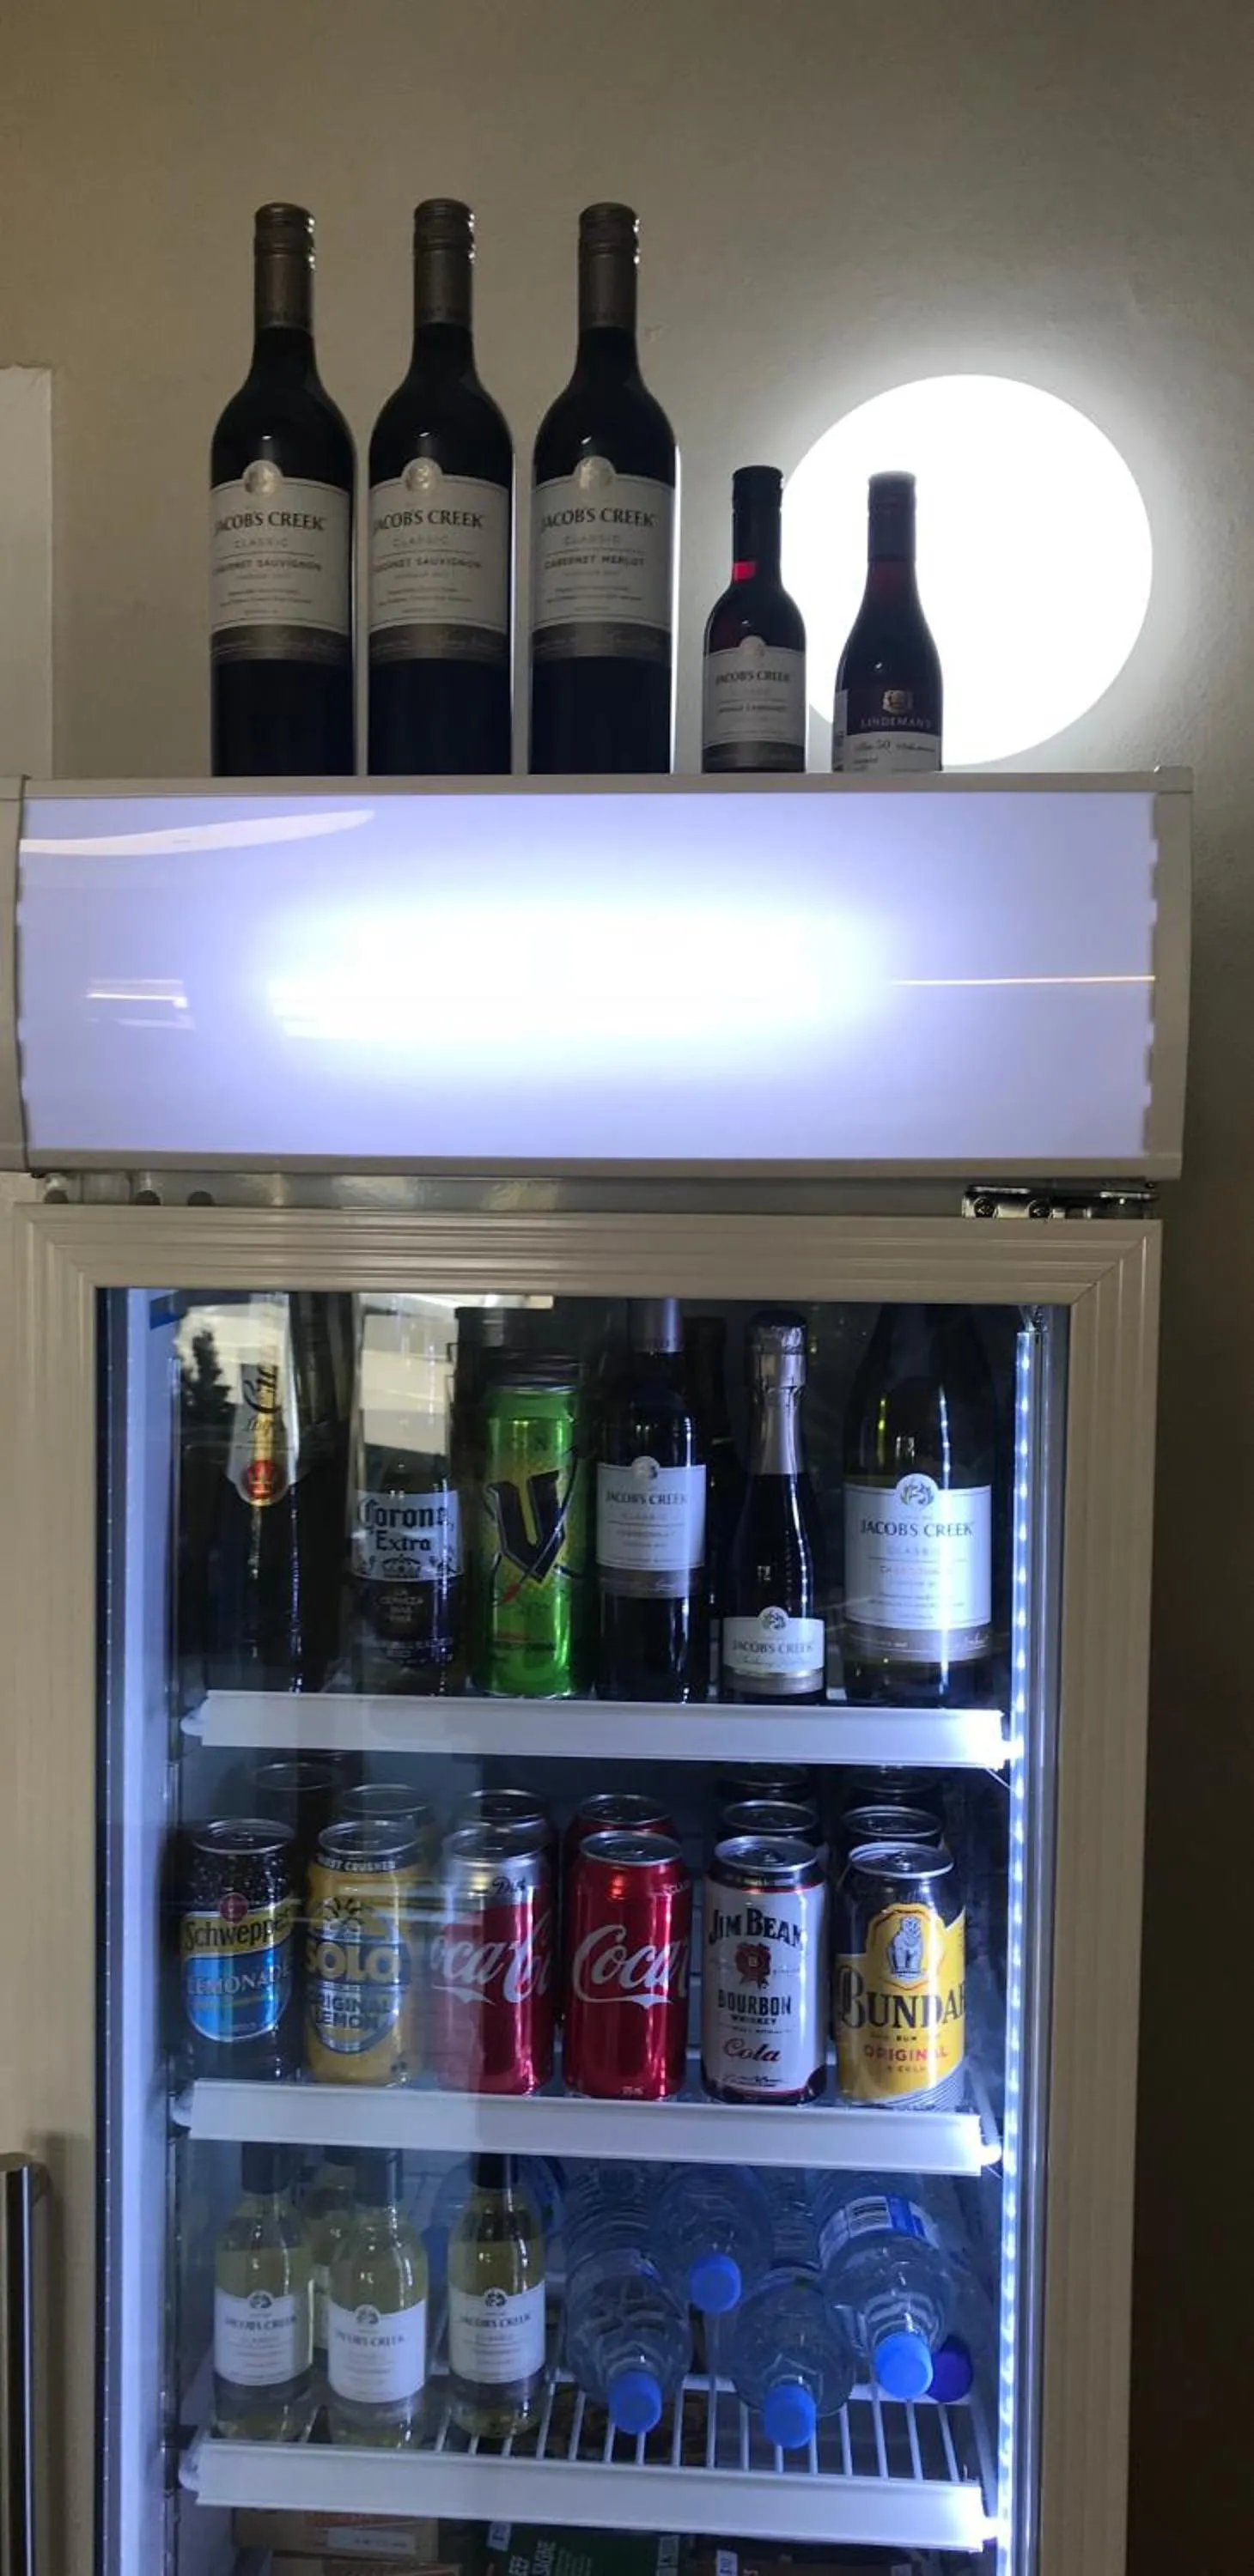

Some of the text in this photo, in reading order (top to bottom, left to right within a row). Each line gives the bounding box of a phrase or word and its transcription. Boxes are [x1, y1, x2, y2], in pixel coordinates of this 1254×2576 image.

[267, 511, 327, 531] CREEK
[427, 509, 486, 529] CREEK
[600, 507, 657, 528] CREEK
[923, 1521, 974, 1538] CREEK
[374, 1530, 432, 1552] Extra
[709, 1909, 742, 1945] JIM
[306, 1941, 402, 1983] SOLO
[717, 1989, 792, 2015] BOURBON
[723, 2037, 782, 2062] Cola
